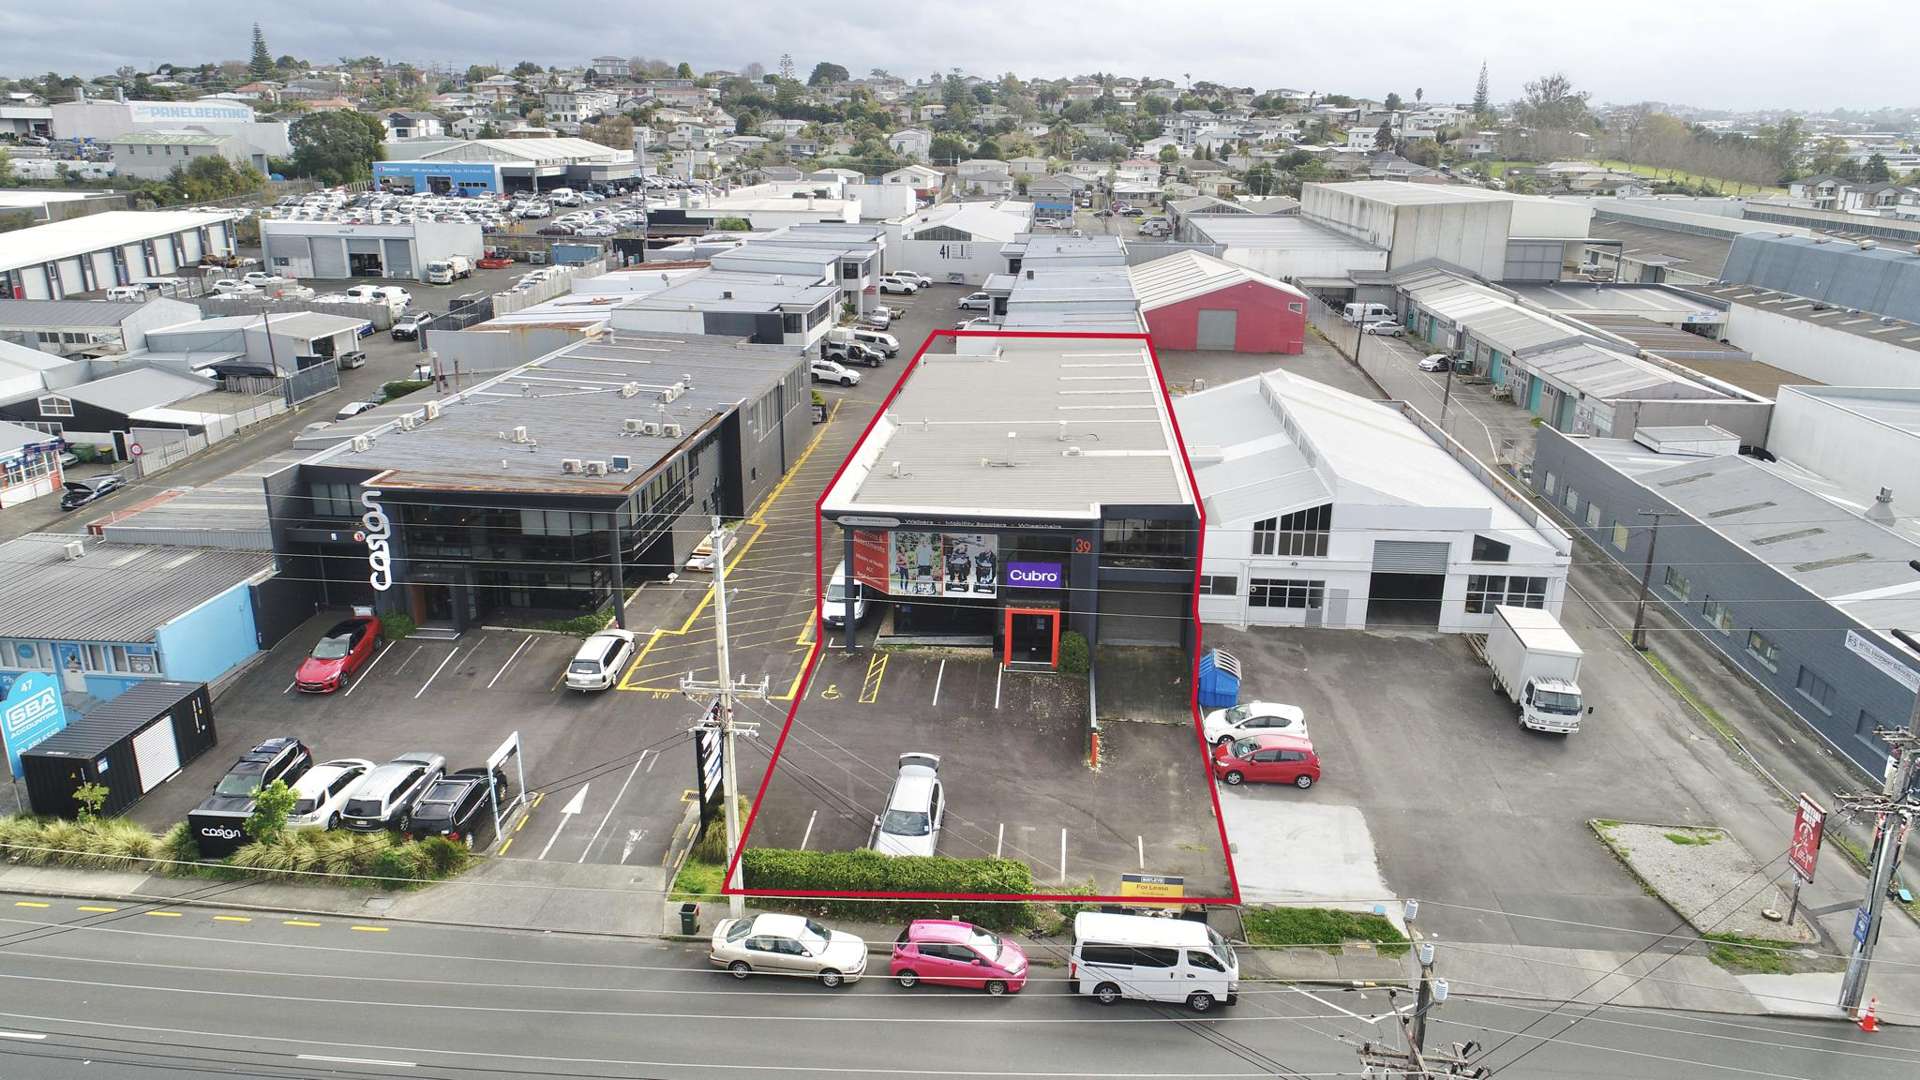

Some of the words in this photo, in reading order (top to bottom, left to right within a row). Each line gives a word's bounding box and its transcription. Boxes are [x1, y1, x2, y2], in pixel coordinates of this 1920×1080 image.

[940, 244, 950, 259] 41
[1075, 538, 1092, 553] 39
[1009, 569, 1058, 582] Cubro
[20, 679, 33, 692] 47
[10, 693, 56, 727] SBA
